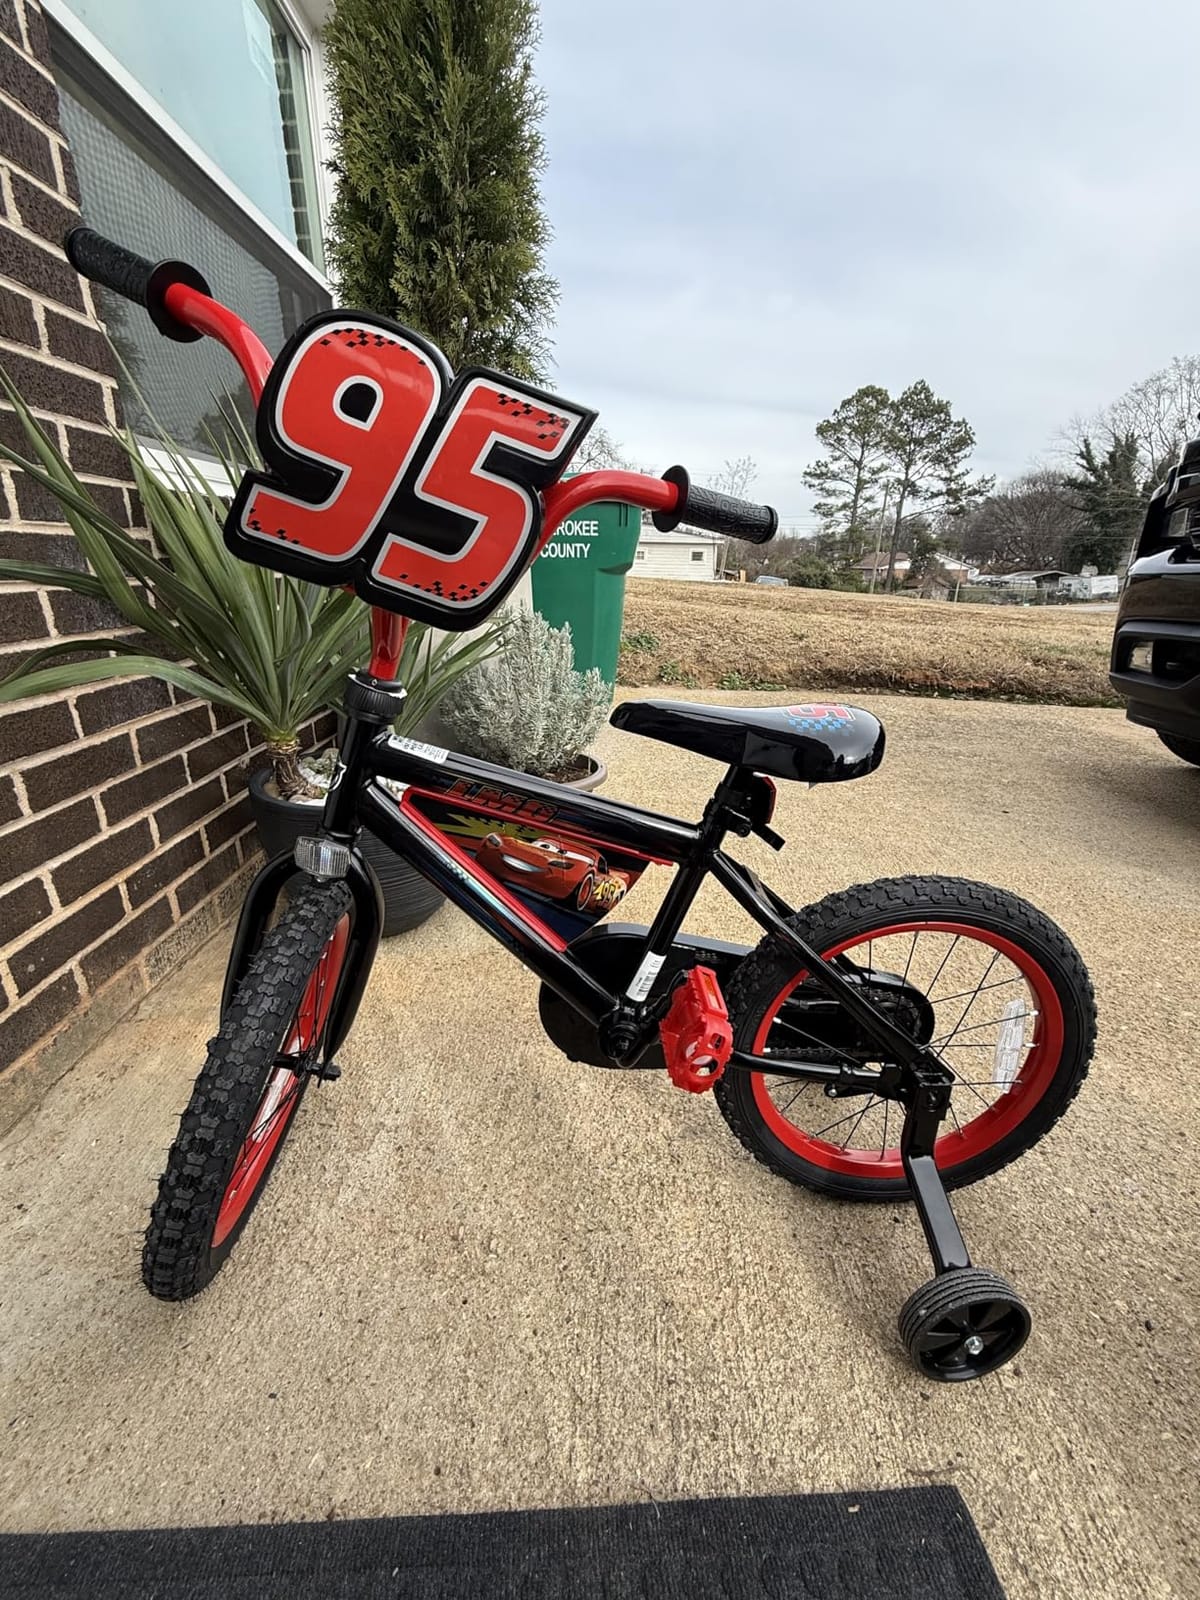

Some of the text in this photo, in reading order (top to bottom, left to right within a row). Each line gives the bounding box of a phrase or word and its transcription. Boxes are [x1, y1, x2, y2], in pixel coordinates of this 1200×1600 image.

[241, 321, 584, 610] 95
[553, 520, 599, 536] ROKEE
[540, 543, 591, 559] COUNTY
